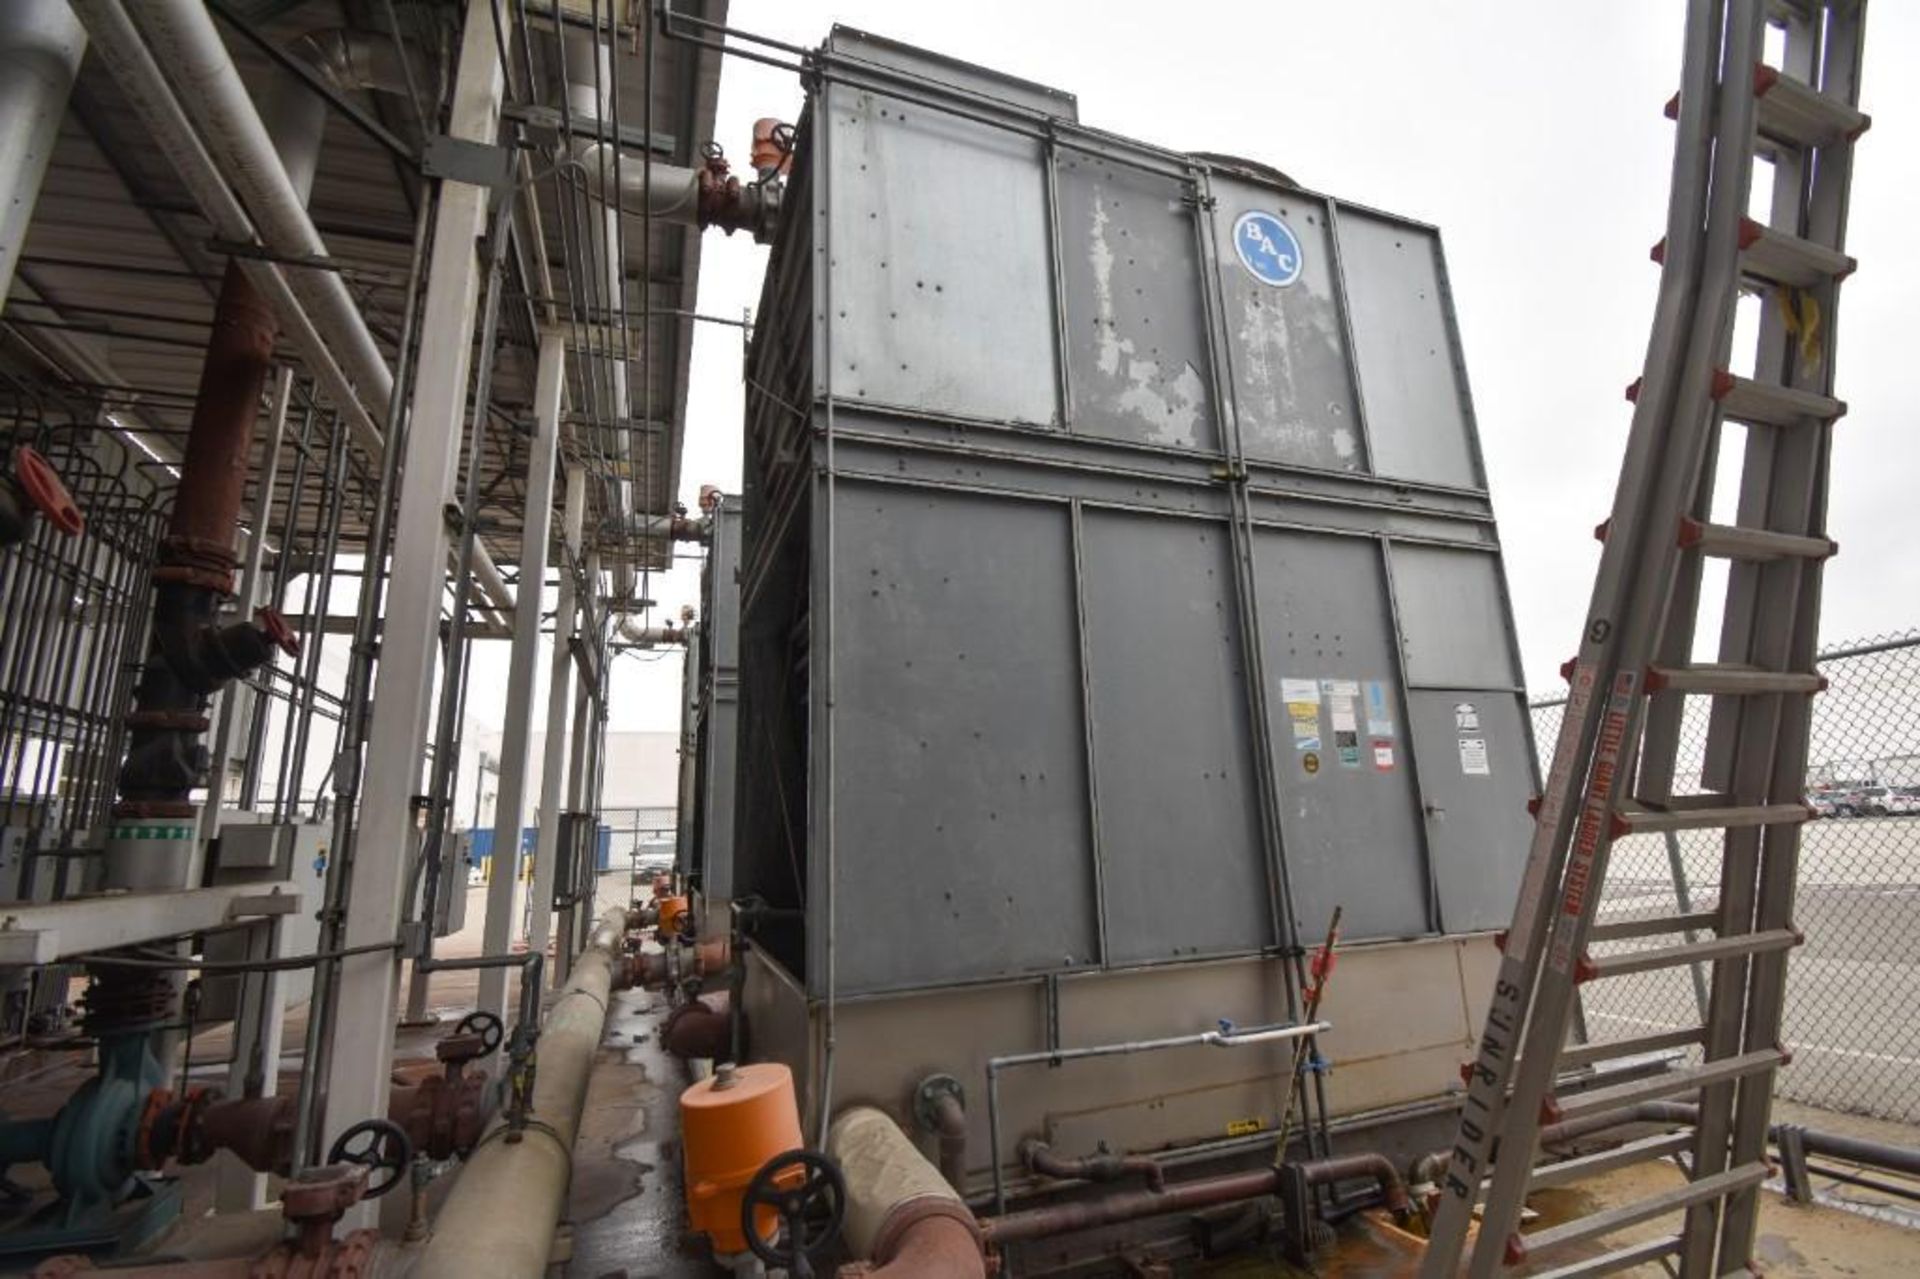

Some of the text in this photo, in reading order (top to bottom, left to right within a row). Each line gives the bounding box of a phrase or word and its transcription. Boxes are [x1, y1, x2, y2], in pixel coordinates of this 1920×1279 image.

[1246, 221, 1293, 272] BAC
[1600, 711, 1626, 754] LITTLE
[1590, 761, 1616, 800] GIANT
[1577, 803, 1606, 857] LADDER
[1563, 860, 1589, 917] SYSTEM
[1446, 979, 1519, 1200] SUNRIDER
